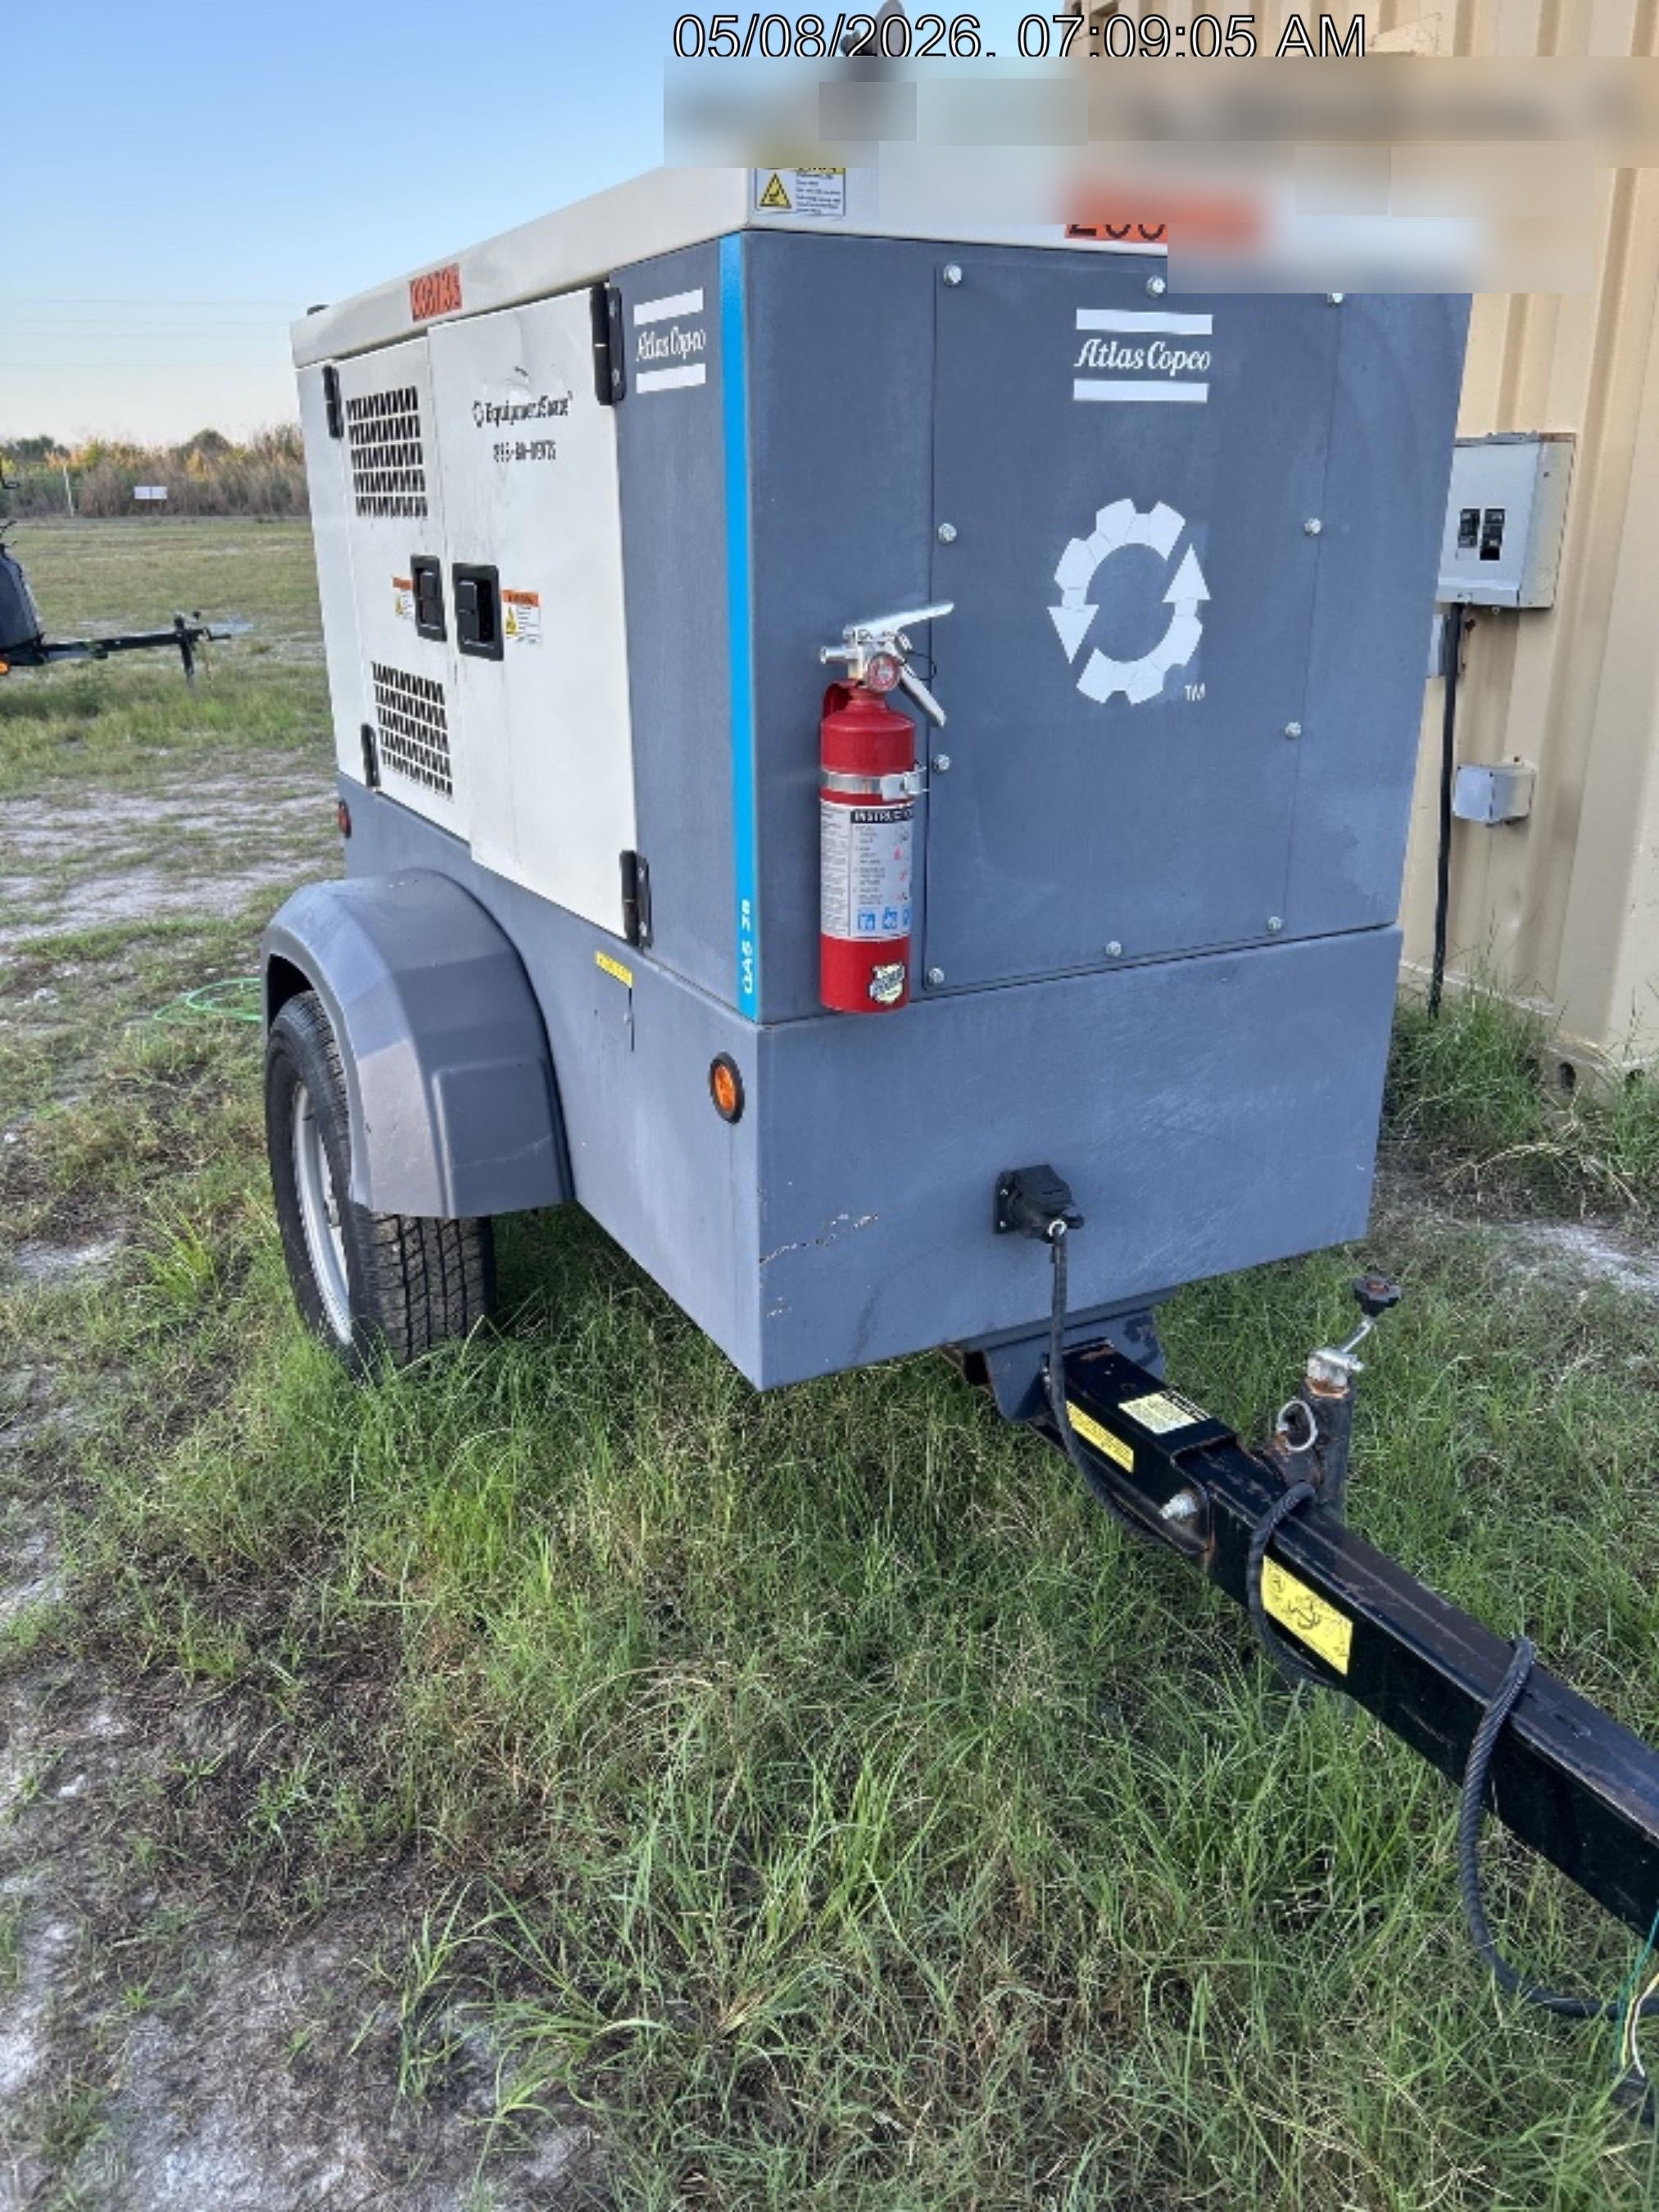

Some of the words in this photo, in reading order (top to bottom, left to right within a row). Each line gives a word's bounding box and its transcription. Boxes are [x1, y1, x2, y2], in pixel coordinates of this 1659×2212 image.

[636, 330, 669, 362] Atlas
[670, 325, 706, 360] Copco
[1074, 338, 1145, 369] Atlas
[1147, 340, 1212, 378] Copco
